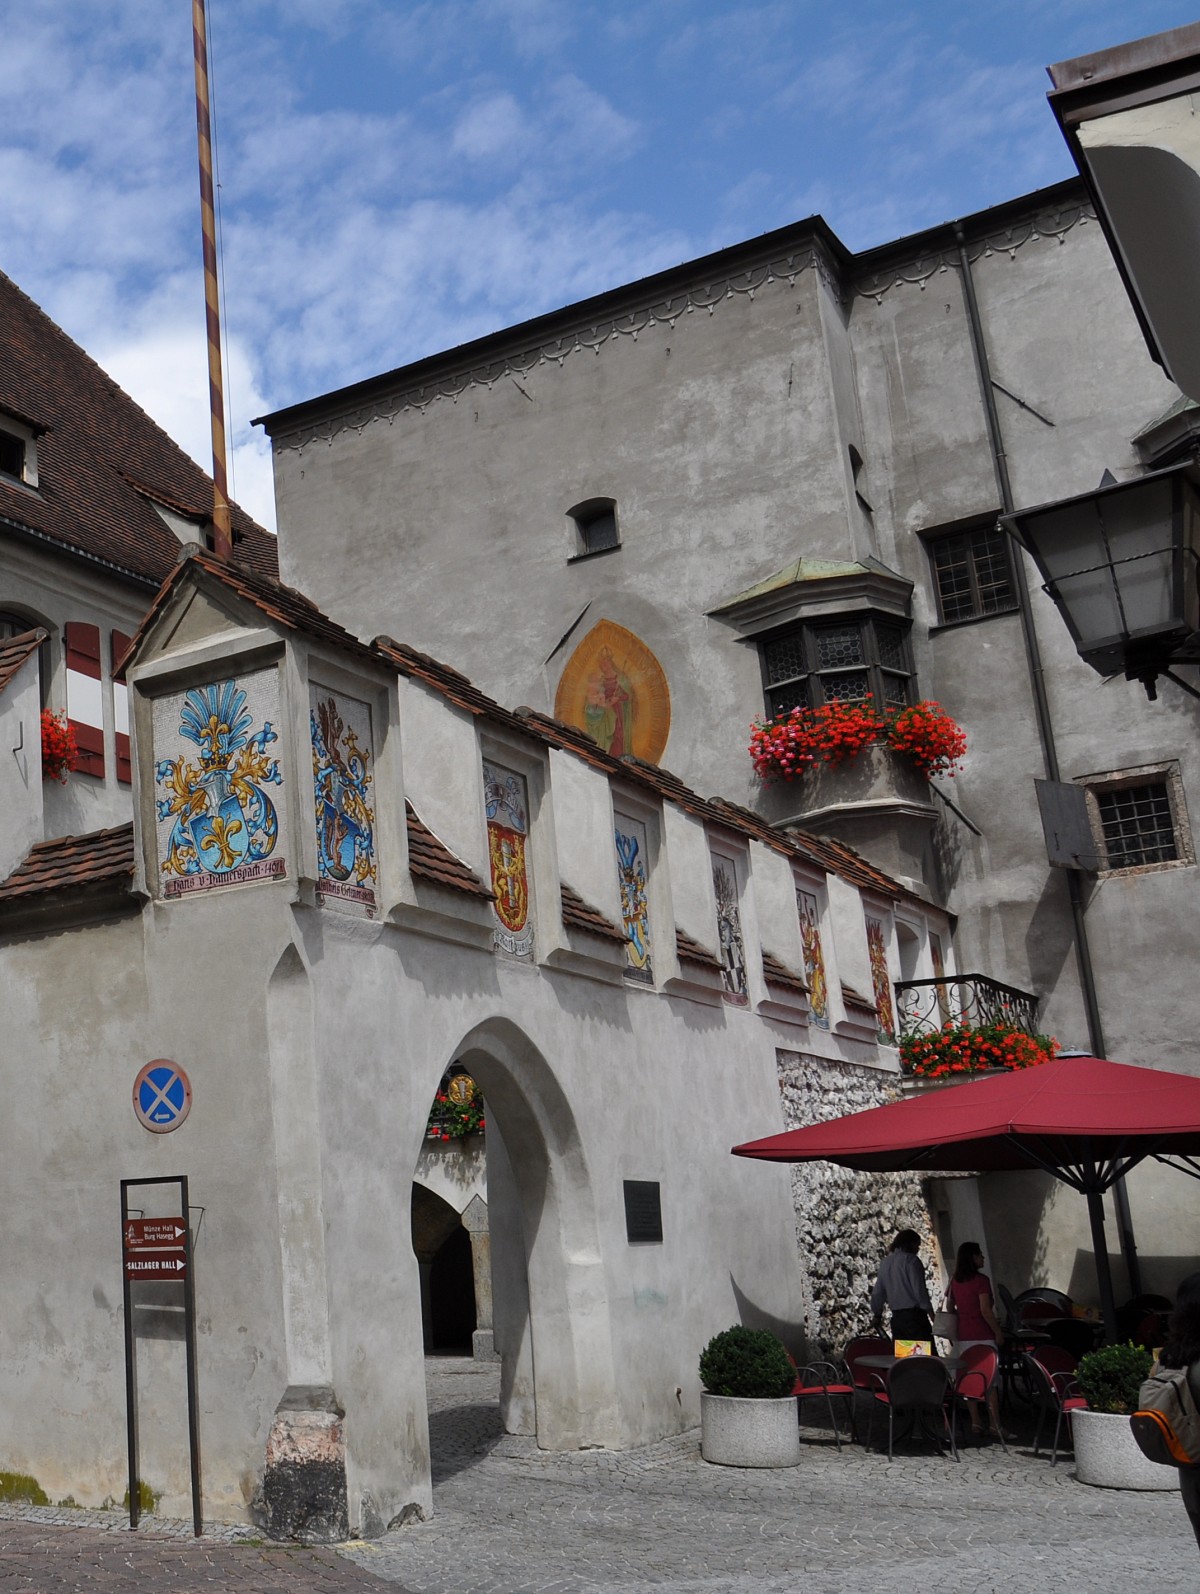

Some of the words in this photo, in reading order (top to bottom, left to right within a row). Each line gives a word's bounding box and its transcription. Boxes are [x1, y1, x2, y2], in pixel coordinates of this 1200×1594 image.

[143, 1225, 161, 1233] Münze
[162, 1224, 174, 1232] Hall
[144, 1233, 156, 1241] Burg
[156, 1233, 174, 1241] Hasegg
[127, 1261, 160, 1270] SALZLAGER
[161, 1260, 176, 1270] HALL
